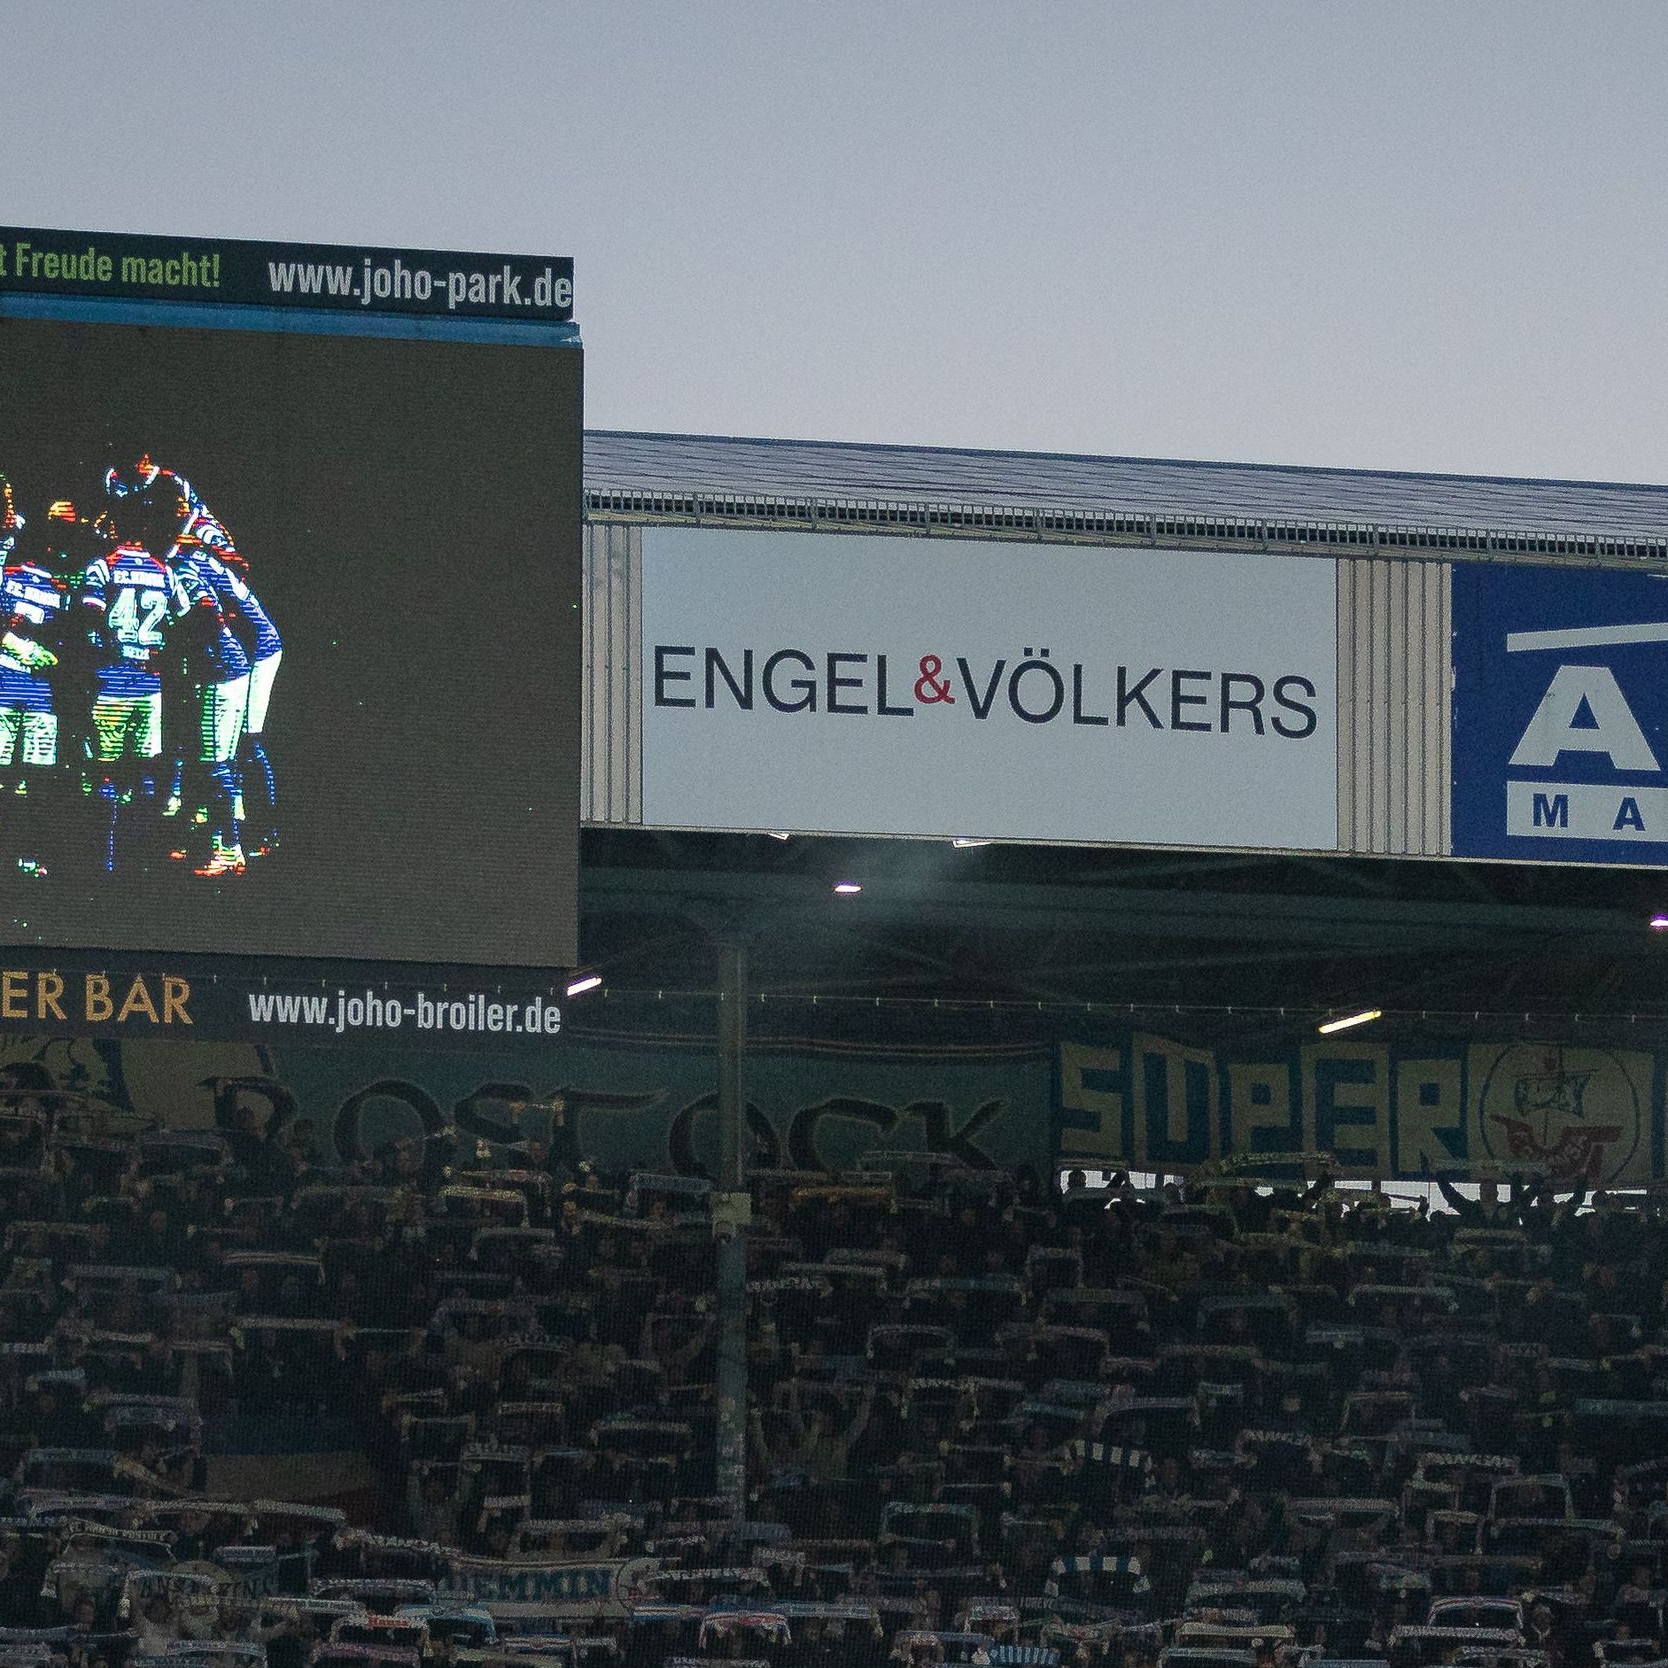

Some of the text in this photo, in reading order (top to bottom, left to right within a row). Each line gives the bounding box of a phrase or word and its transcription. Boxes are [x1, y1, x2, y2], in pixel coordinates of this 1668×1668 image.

[16, 242, 112, 282] Freude
[122, 252, 220, 288] macht!
[268, 258, 572, 309] www.joho-park.de
[109, 588, 168, 645] 42
[654, 645, 1317, 739] ENGEL&VÖLKERS
[85, 973, 193, 1024] BAR
[249, 990, 561, 1034] www.joho-broiler.de
[1059, 1033, 1468, 1177] SUPER
